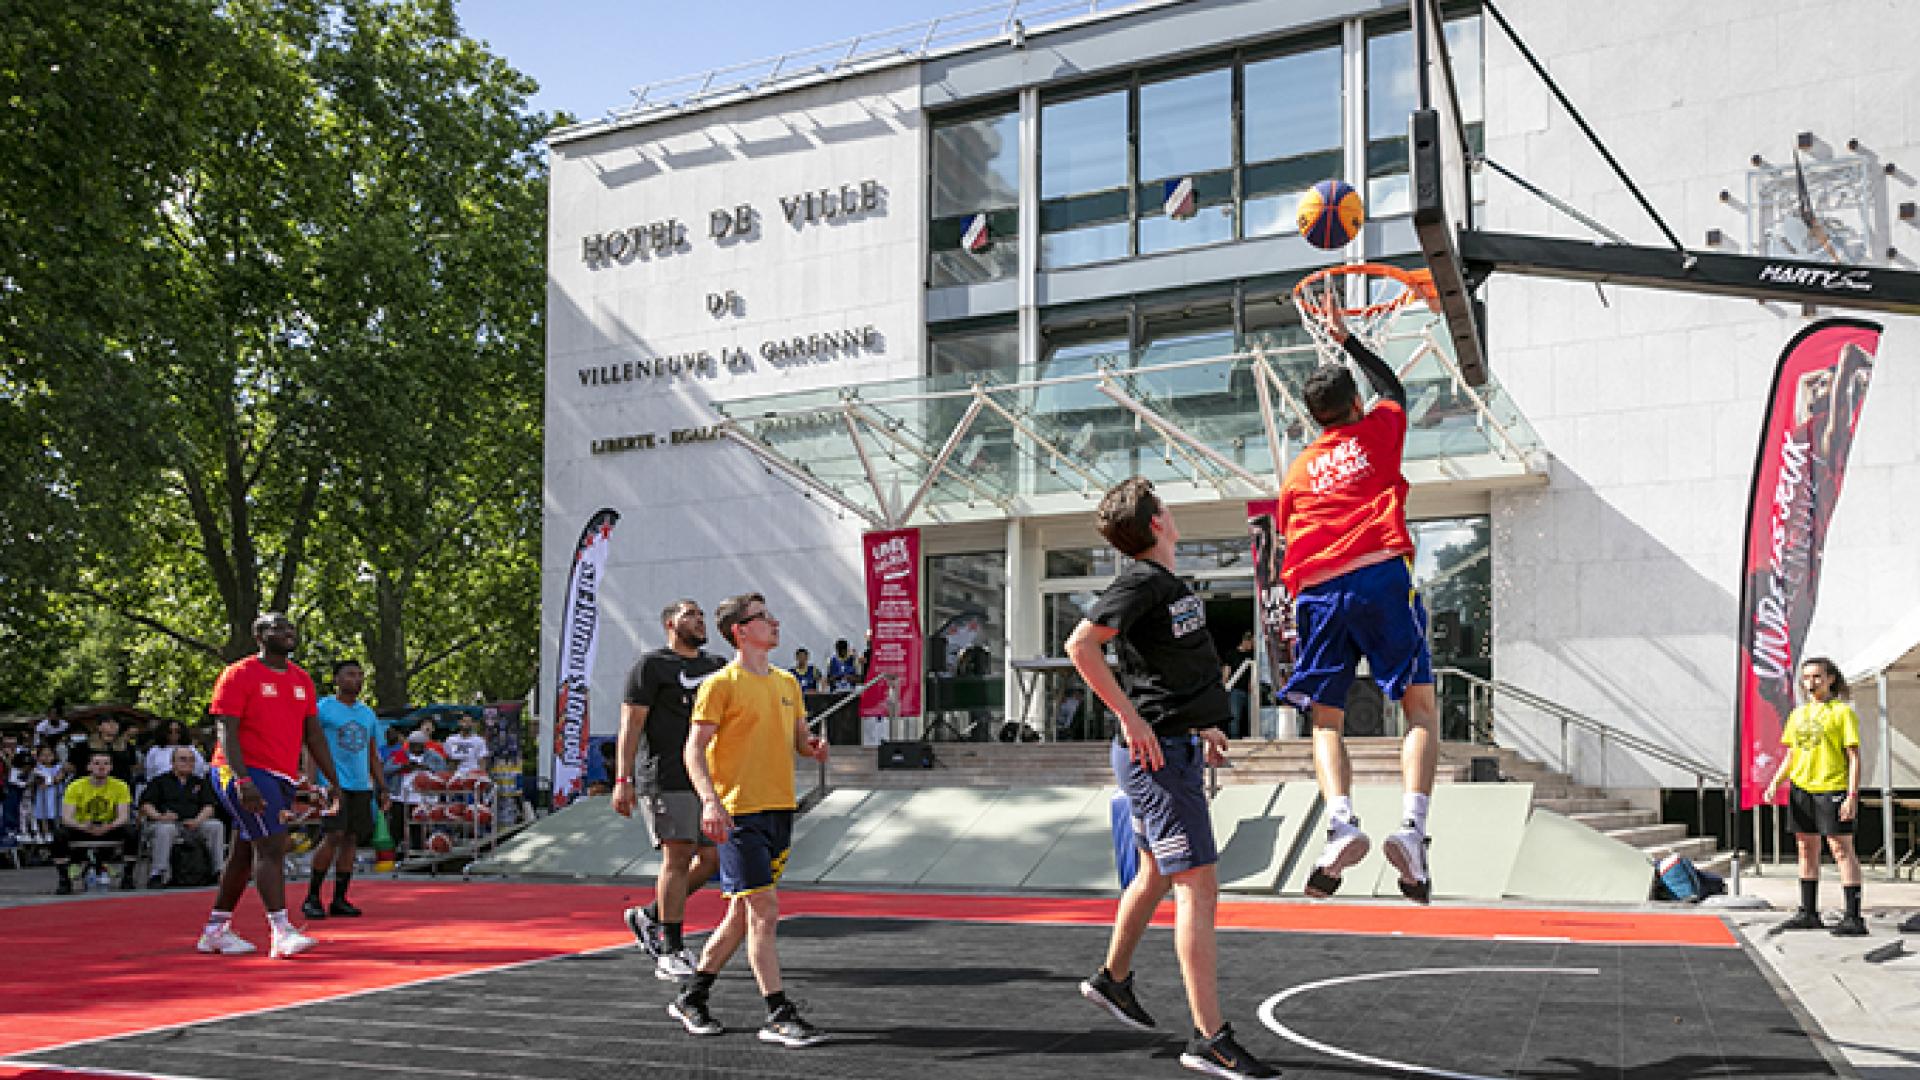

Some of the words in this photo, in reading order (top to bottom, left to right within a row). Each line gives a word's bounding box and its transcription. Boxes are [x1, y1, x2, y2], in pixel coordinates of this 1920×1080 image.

[708, 203, 751, 239] DE
[779, 180, 877, 222] VILLE
[706, 290, 739, 318] DE
[578, 350, 710, 387] VILLENEUVE
[722, 347, 748, 366] LA
[759, 324, 874, 361] GARENNE
[590, 431, 656, 456] LIBERTE
